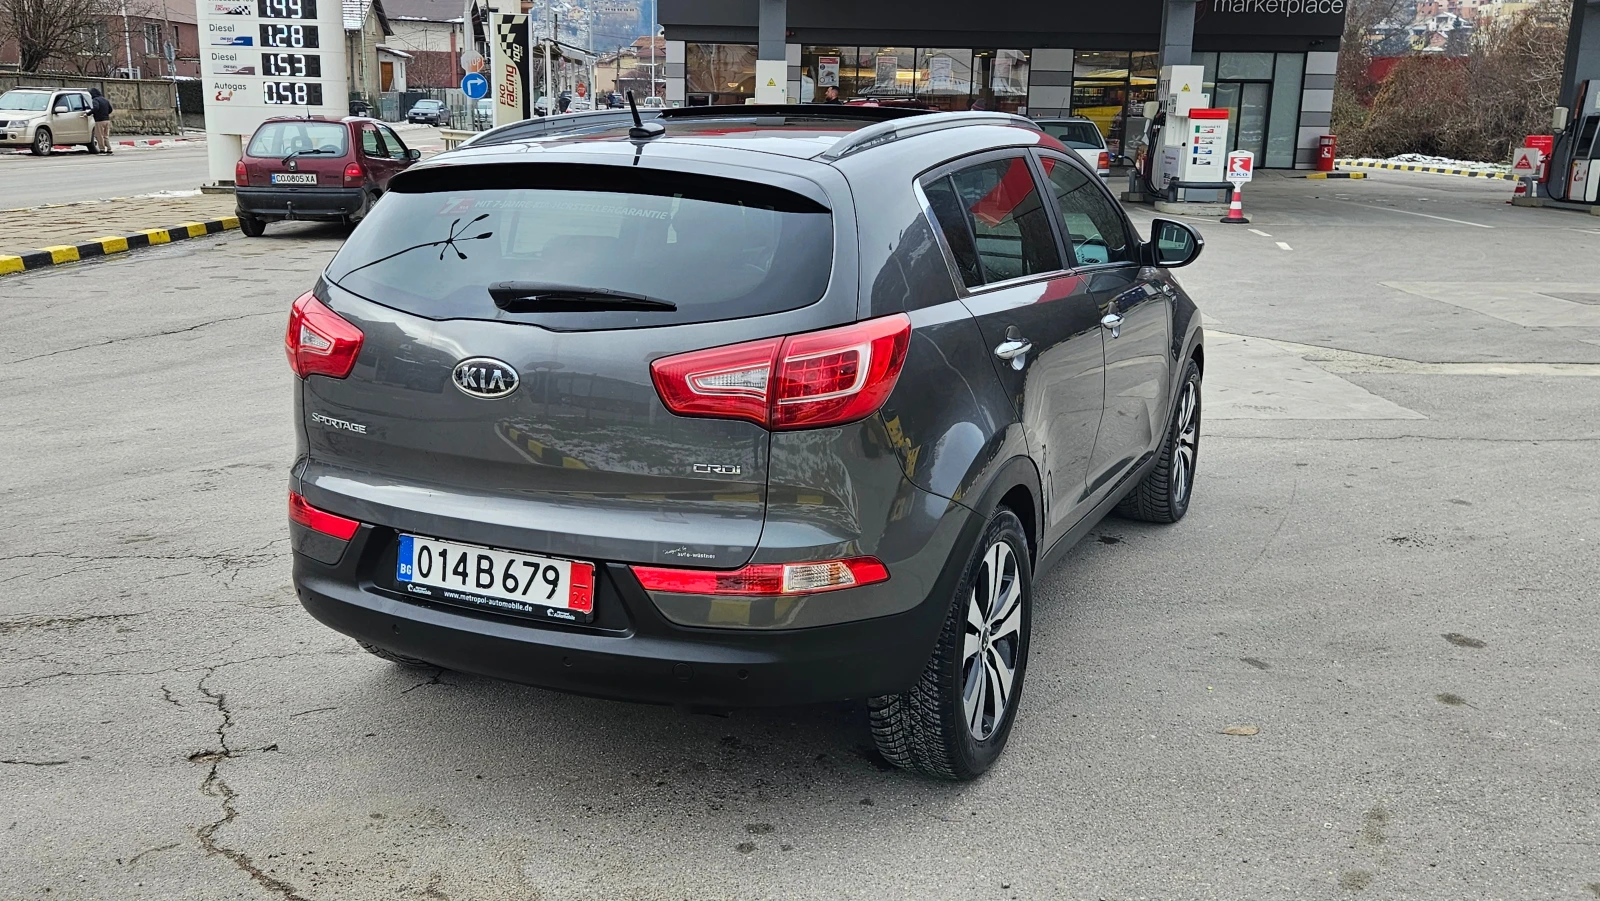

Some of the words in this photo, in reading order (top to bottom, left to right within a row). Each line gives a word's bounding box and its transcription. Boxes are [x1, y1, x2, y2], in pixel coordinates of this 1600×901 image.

[266, 0, 302, 18] 1.49
[1213, 0, 1344, 17] marketplace
[209, 23, 235, 32] Diesel
[268, 25, 304, 47] 1.28
[211, 53, 237, 61] Diesel
[512, 43, 521, 62] 100
[270, 54, 306, 76] 1.53
[214, 82, 247, 91] Autogas
[264, 82, 307, 104] 0.58
[505, 64, 517, 108] racing
[474, 200, 494, 209] MIT
[461, 365, 506, 390] KIA
[311, 412, 367, 435] SPORTAGE
[400, 563, 412, 575] BG
[443, 589, 533, 612] www.metropol-automobile.de
